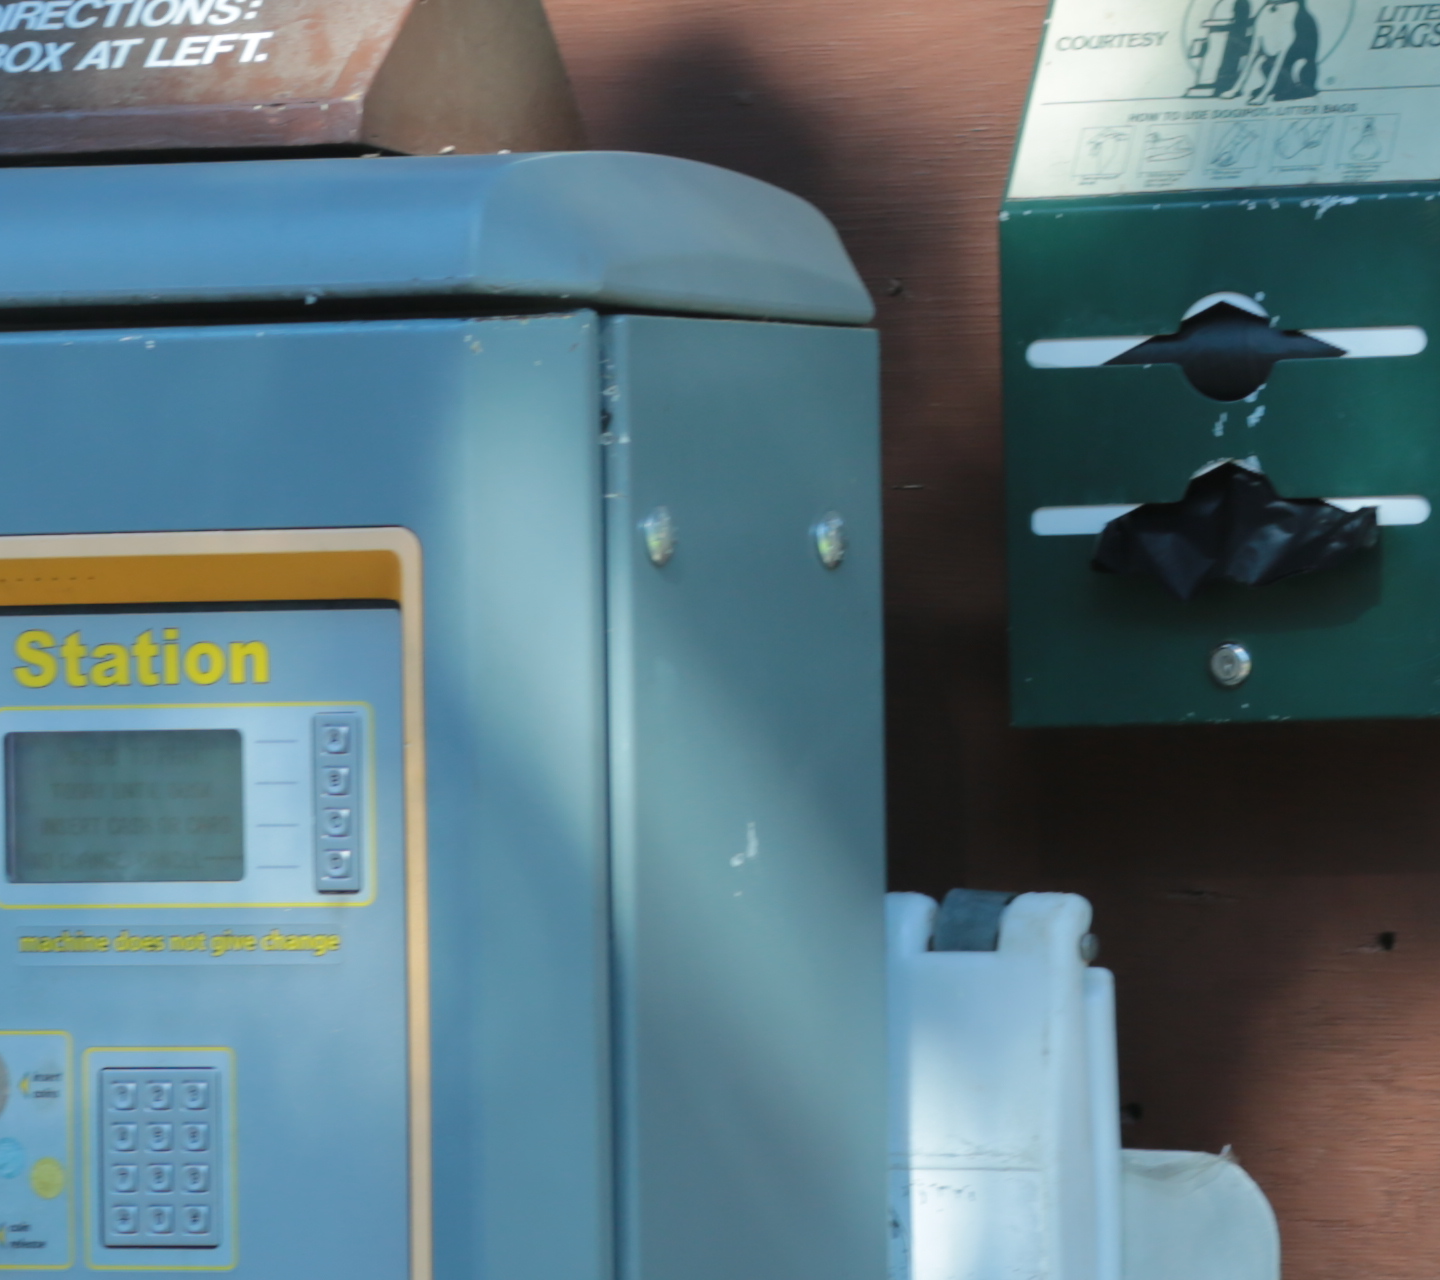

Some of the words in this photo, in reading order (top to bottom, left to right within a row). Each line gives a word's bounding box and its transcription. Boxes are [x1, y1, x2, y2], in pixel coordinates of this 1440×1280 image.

[73, 39, 136, 72] AT
[145, 31, 274, 68] LEFT.
[1056, 30, 1169, 51] COURTESY
[12, 628, 271, 689] Station
[19, 930, 110, 953] machine
[113, 931, 165, 952] does
[170, 932, 207, 951] not
[210, 929, 257, 957] give
[261, 929, 341, 956] change
